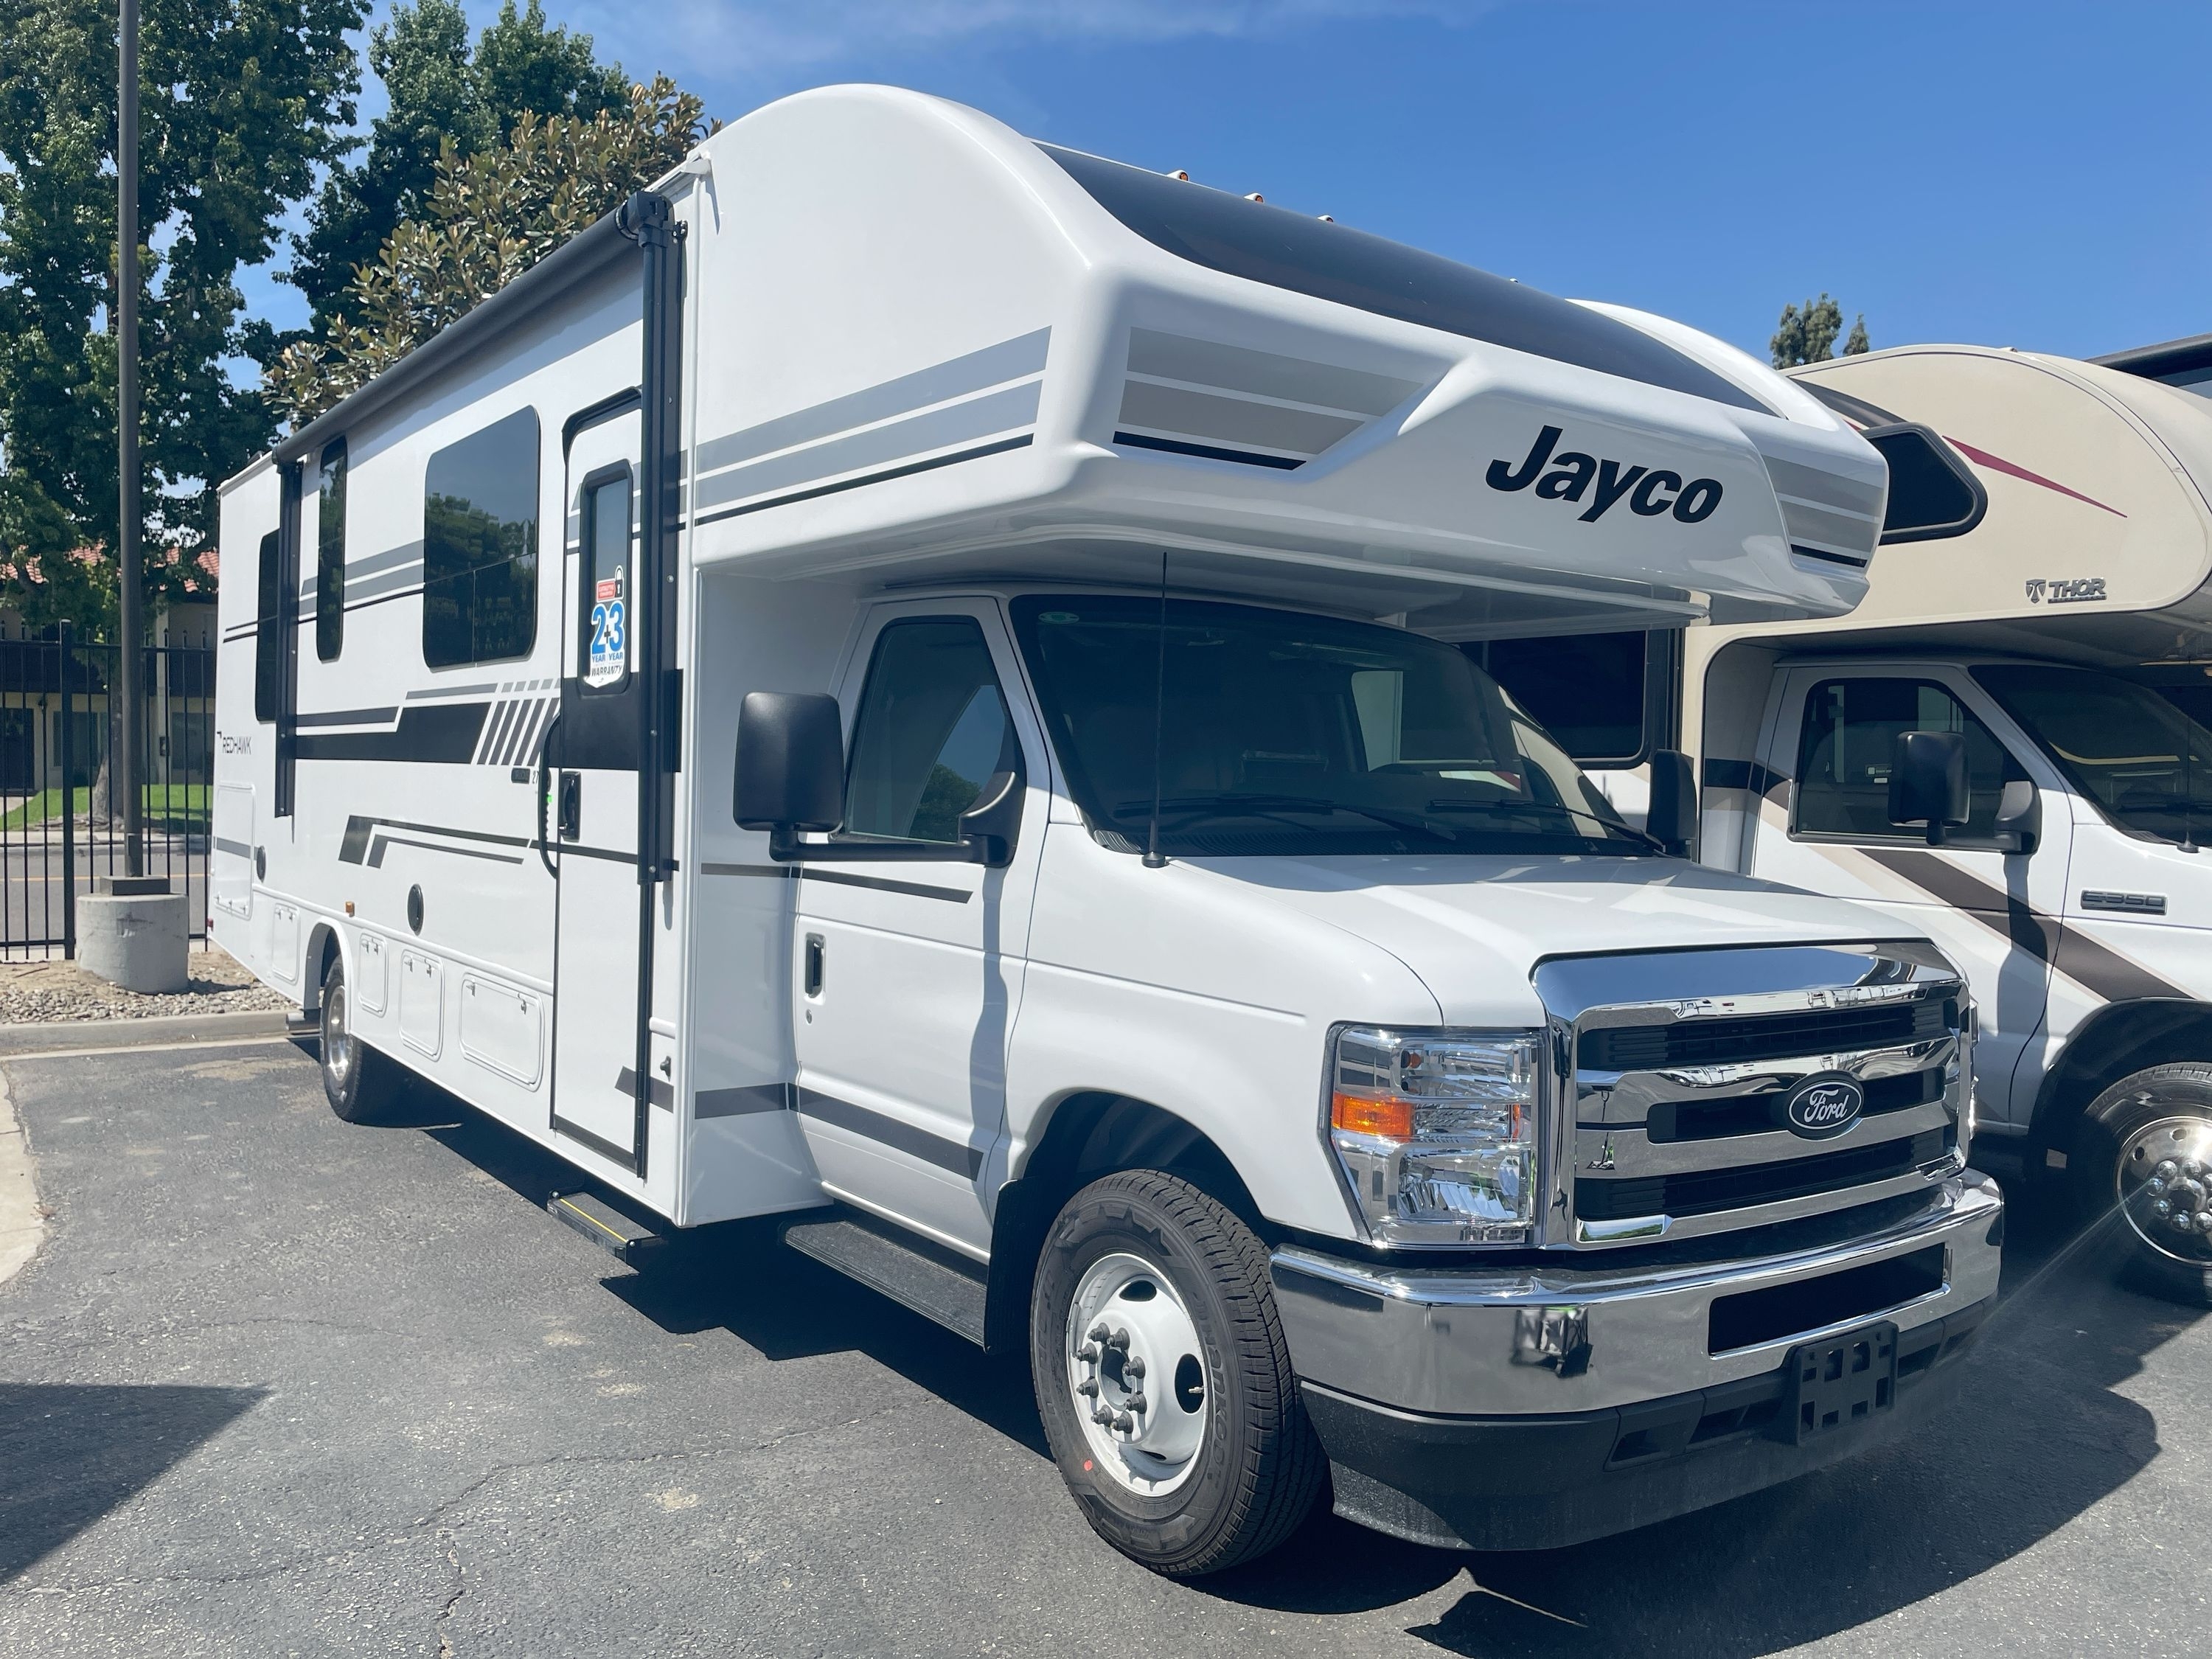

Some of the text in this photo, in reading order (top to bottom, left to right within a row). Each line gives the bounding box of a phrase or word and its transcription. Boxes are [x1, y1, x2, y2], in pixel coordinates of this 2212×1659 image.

[1485, 425, 1723, 524] Jayco
[2048, 578, 2107, 598] THOR
[592, 652, 624, 663] YEAR YEAR
[591, 664, 623, 677] WARRANTY
[222, 737, 251, 755] REDHAWK
[1804, 1089, 1849, 1123] Ford
